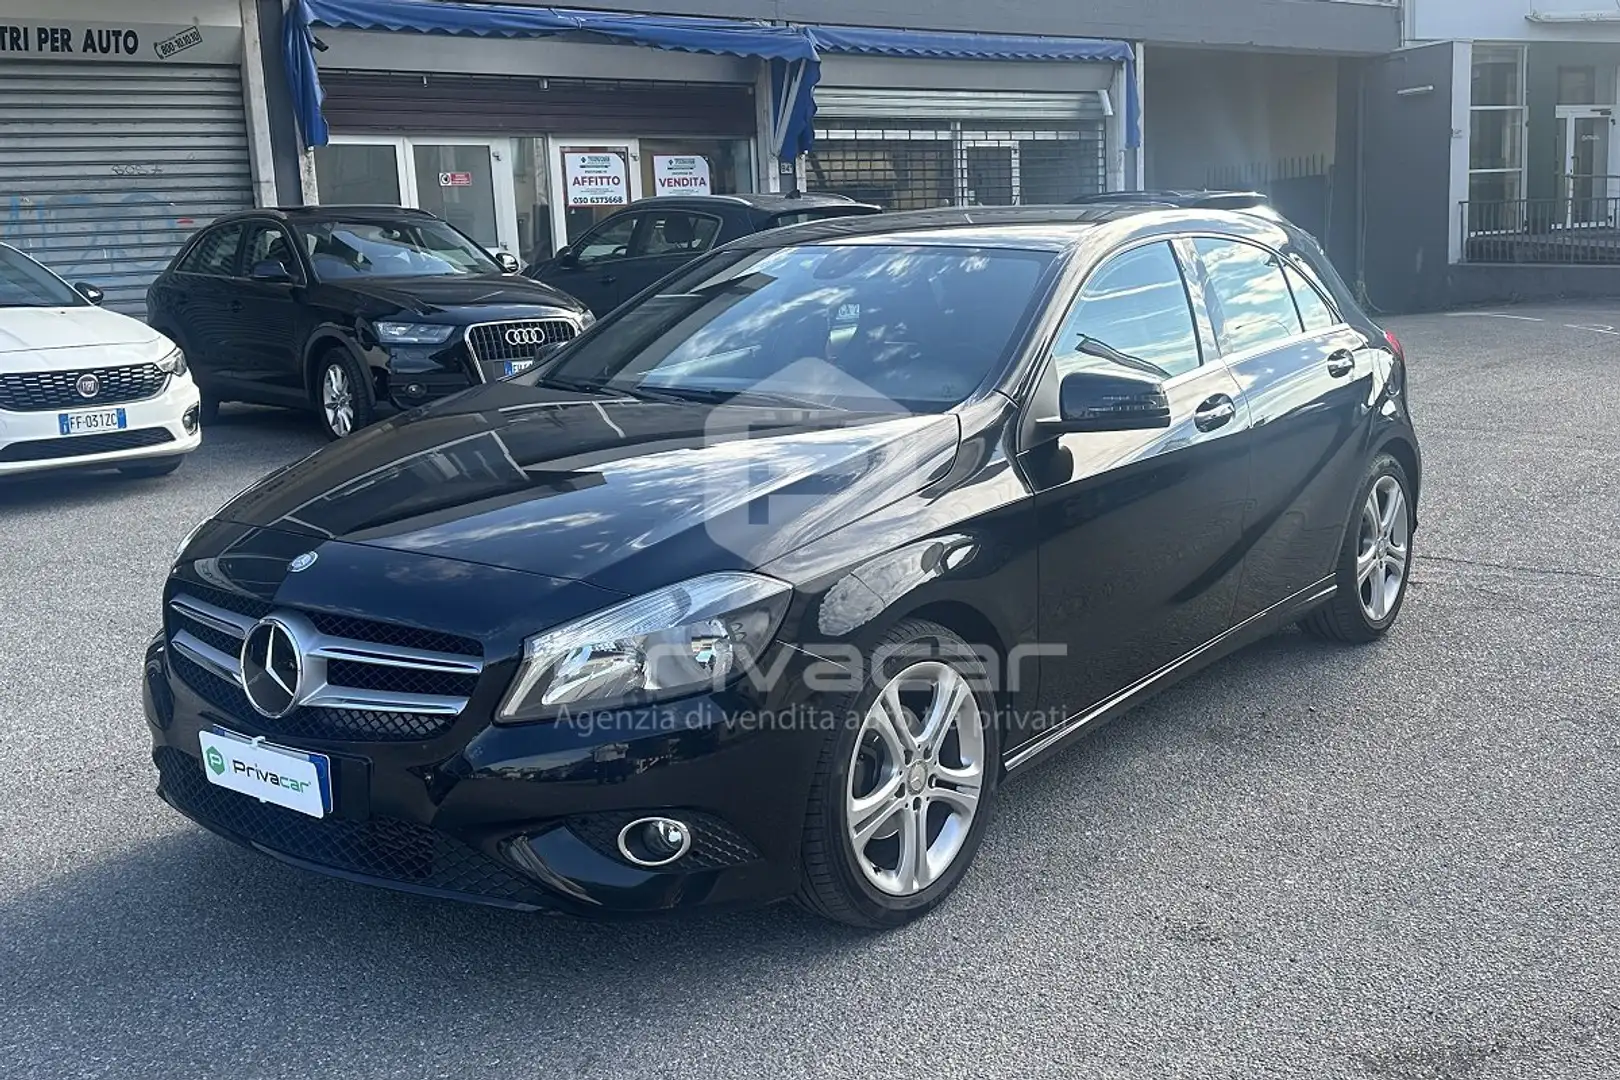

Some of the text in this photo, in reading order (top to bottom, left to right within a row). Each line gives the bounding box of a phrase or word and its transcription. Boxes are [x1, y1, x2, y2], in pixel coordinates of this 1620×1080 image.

[0, 26, 139, 55] TRI PER AUTO
[572, 176, 621, 186] AFFITTO
[658, 177, 707, 188] VENDITA
[232, 759, 311, 793] Privacar
